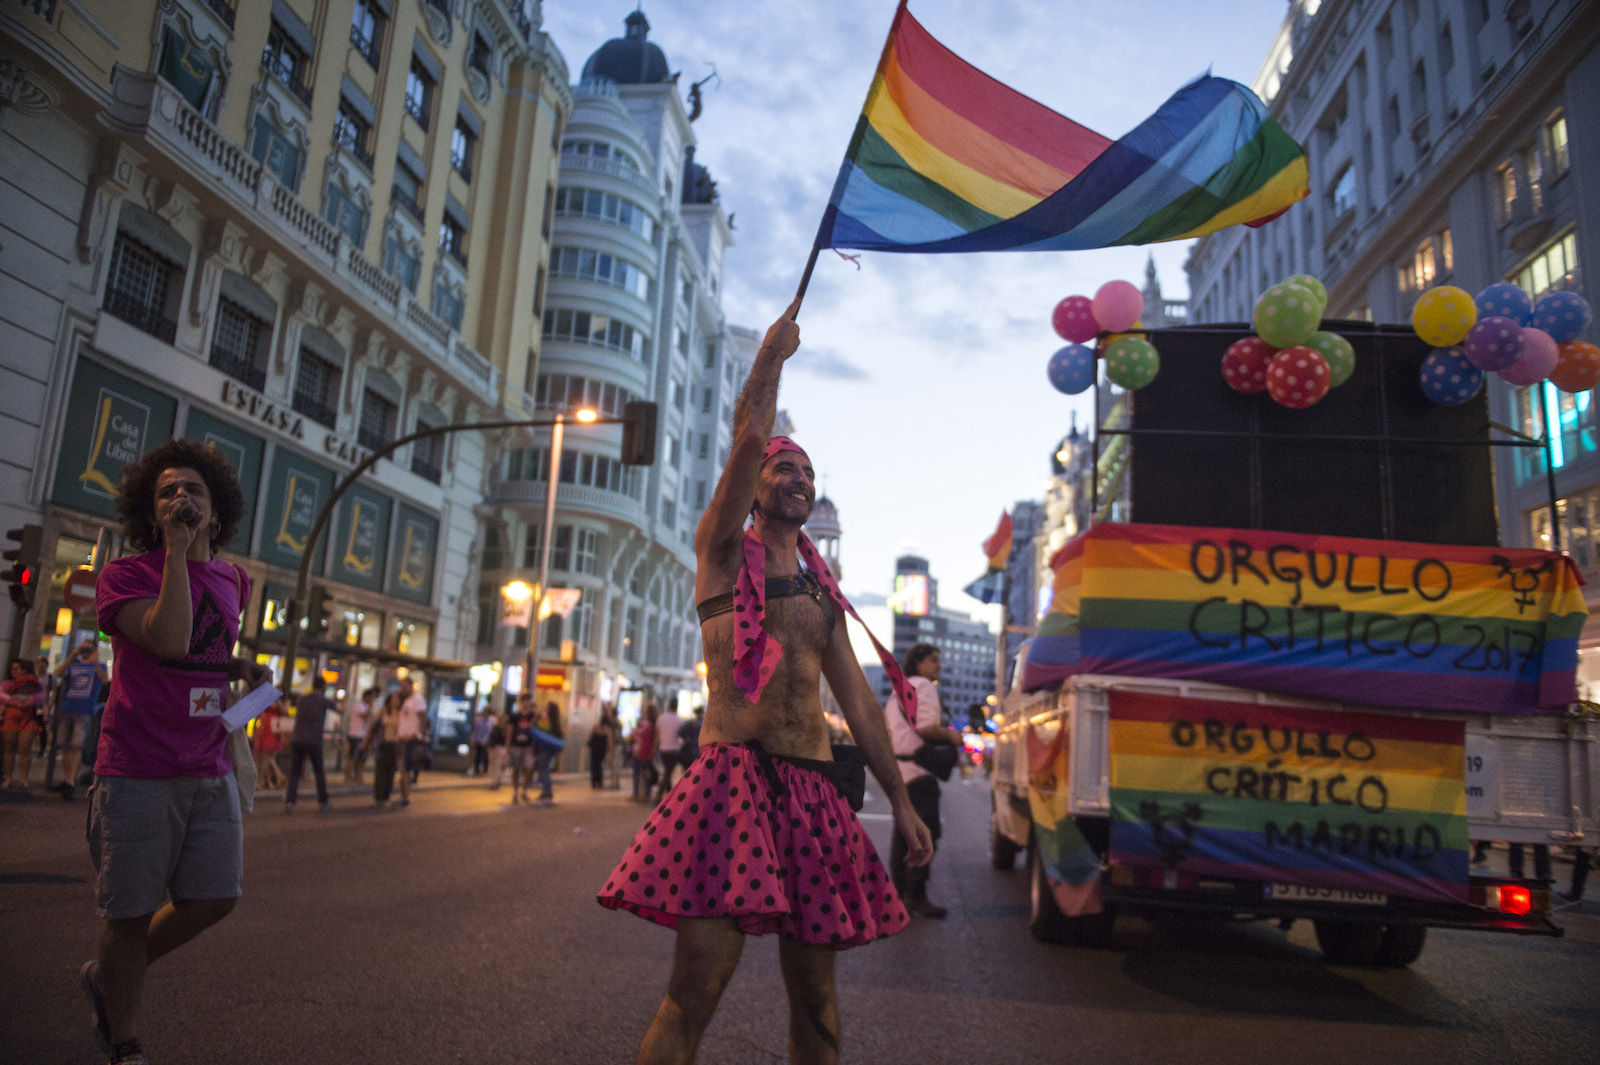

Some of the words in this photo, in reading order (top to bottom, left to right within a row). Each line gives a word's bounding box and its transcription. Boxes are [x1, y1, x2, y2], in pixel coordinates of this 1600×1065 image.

[111, 414, 139, 438] Casa
[222, 380, 303, 438] ESPASA
[106, 440, 136, 463] Libro
[122, 435, 138, 450] del
[1190, 540, 1453, 605] ORGULLO
[1454, 625, 1538, 676] 2017
[1171, 718, 1377, 762] ORGULLO
[1207, 758, 1389, 814] CRÍTICO
[1465, 787, 1484, 797] m
[1265, 820, 1441, 863] MADRID
